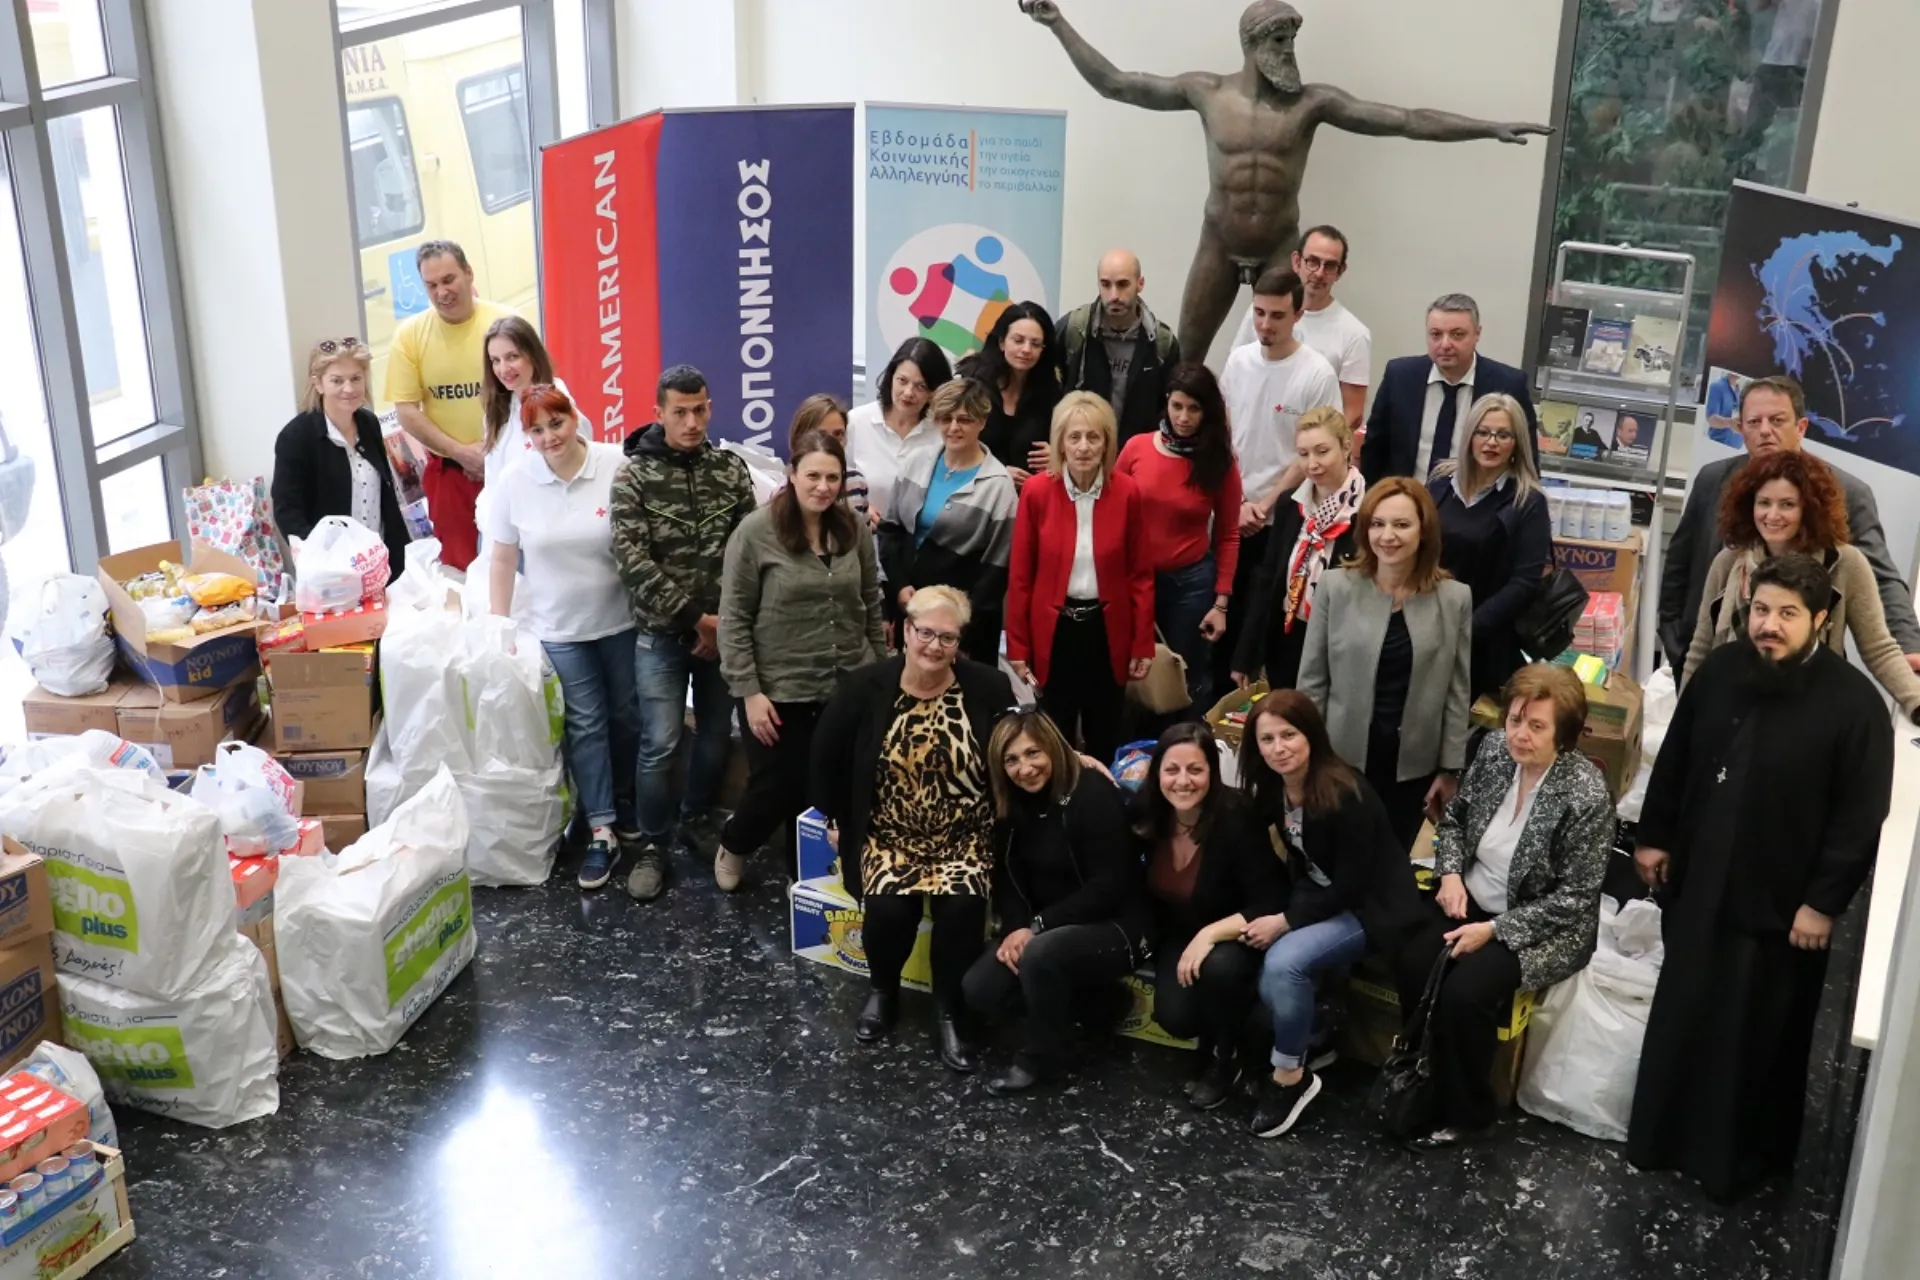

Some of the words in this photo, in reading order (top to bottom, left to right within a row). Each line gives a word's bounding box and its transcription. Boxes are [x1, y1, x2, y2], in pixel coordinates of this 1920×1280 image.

[343, 44, 387, 75] ΝΙΑ
[869, 130, 969, 150] Εβδομάδα
[978, 136, 997, 148] για
[998, 137, 1013, 147] το
[869, 149, 969, 169] Κοινωνικής
[979, 151, 998, 162] την
[1000, 149, 1032, 163] υγεία
[869, 165, 969, 187] Αλληλεγγύης
[978, 165, 998, 177] την
[977, 179, 991, 189] το
[594, 150, 624, 444] ERAMERICAN
[738, 158, 775, 456] ΛΟΠΟΝΝΗΣΟΣ
[428, 382, 481, 399] FEGUA
[188, 665, 213, 683] kid
[824, 910, 864, 923] BANA
[81, 915, 128, 939] plus
